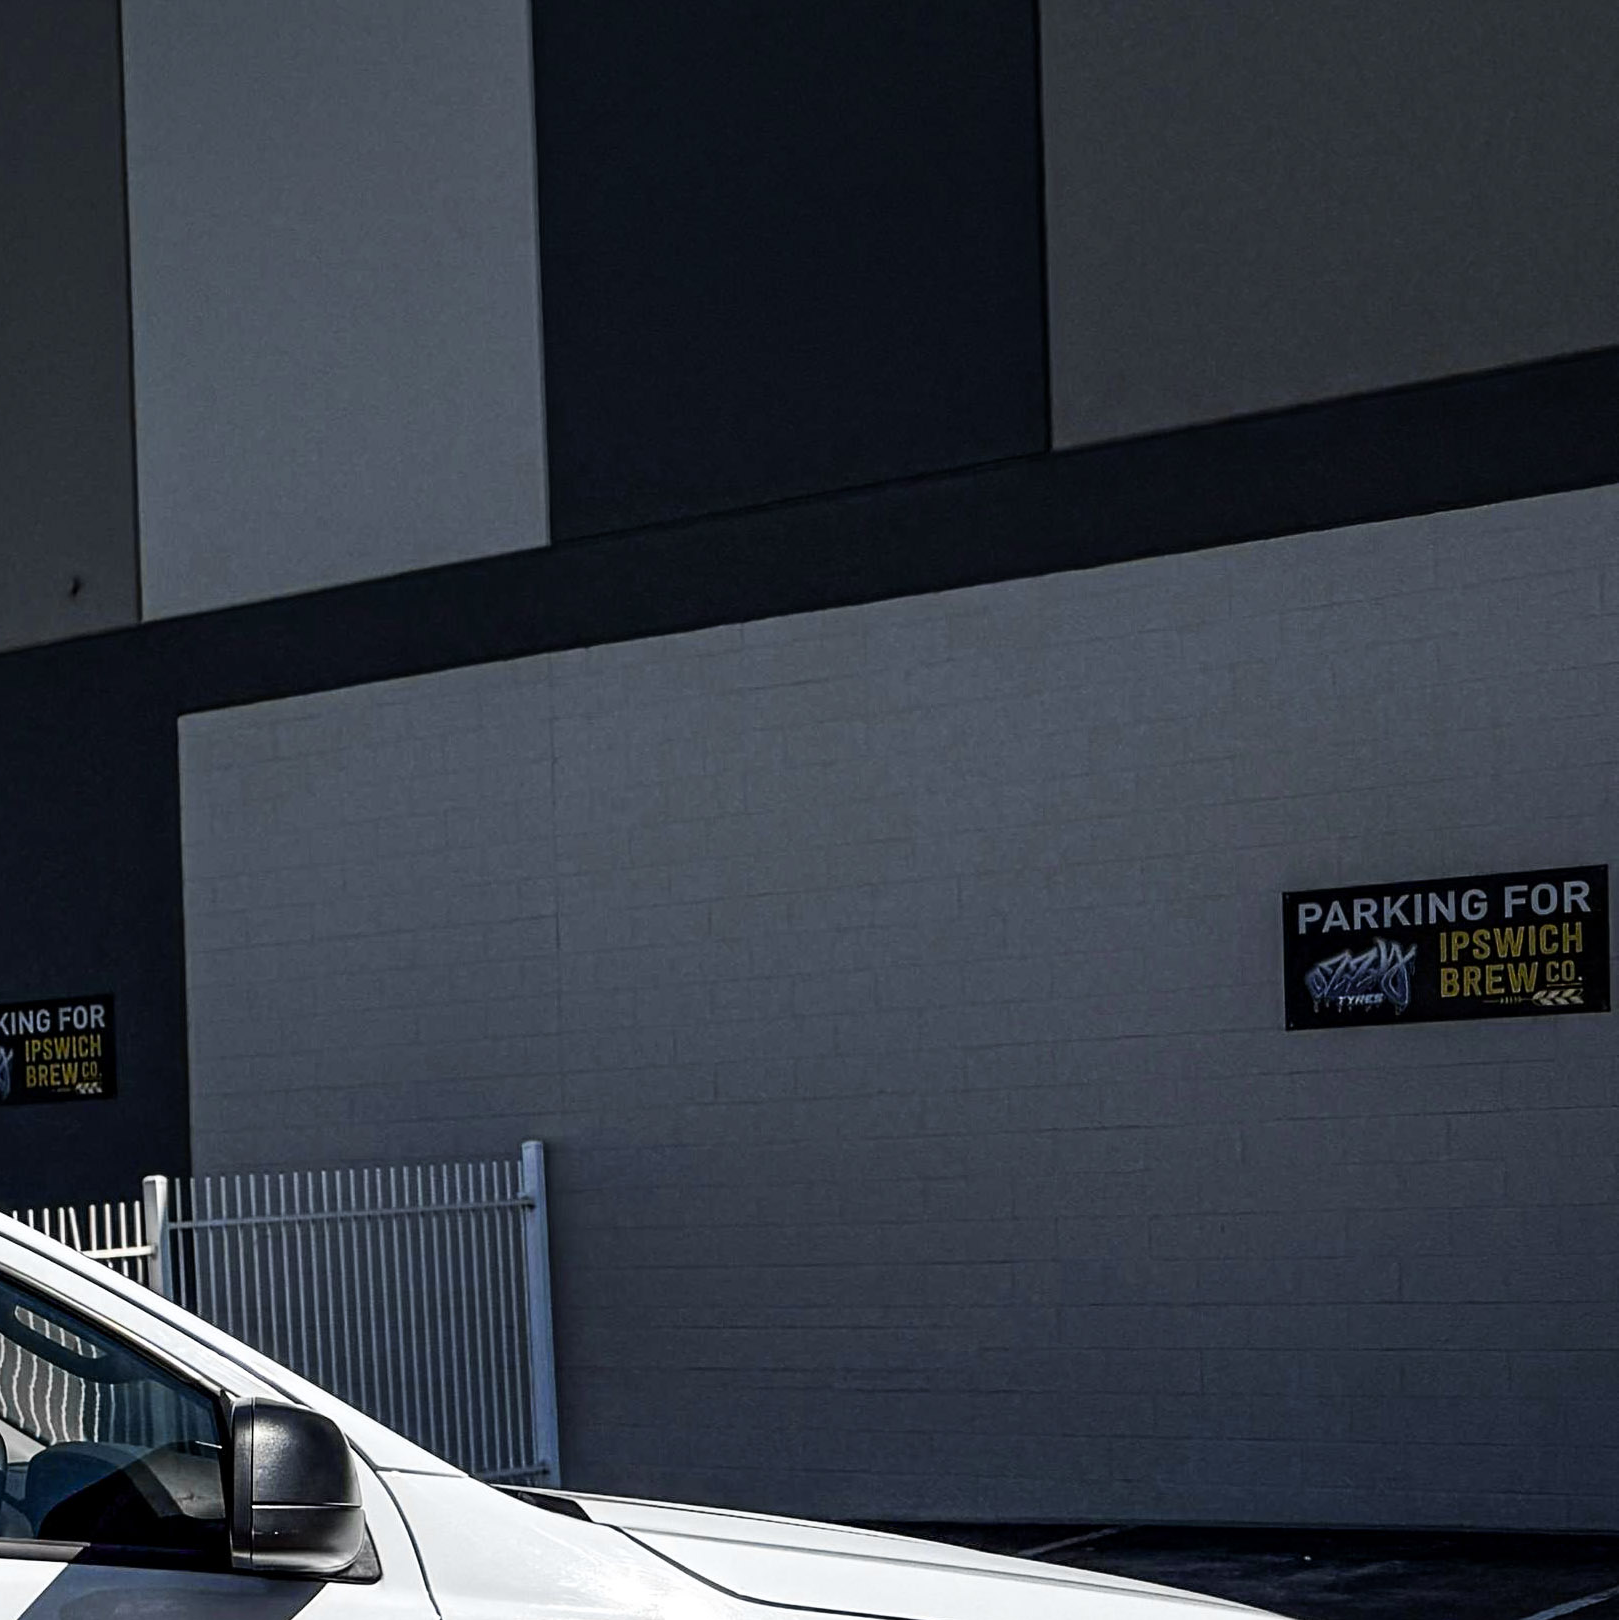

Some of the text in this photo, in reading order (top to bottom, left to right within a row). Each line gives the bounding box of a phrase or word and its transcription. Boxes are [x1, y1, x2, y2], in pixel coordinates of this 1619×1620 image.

[1298, 880, 1591, 935] PARKING FOR
[1440, 922, 1583, 963] IPSWICH
[1440, 960, 1583, 998] BREW CO.
[58, 1004, 105, 1031] FOR
[25, 1034, 101, 1062] IPSWICH
[26, 1061, 103, 1088] BREW CO.
